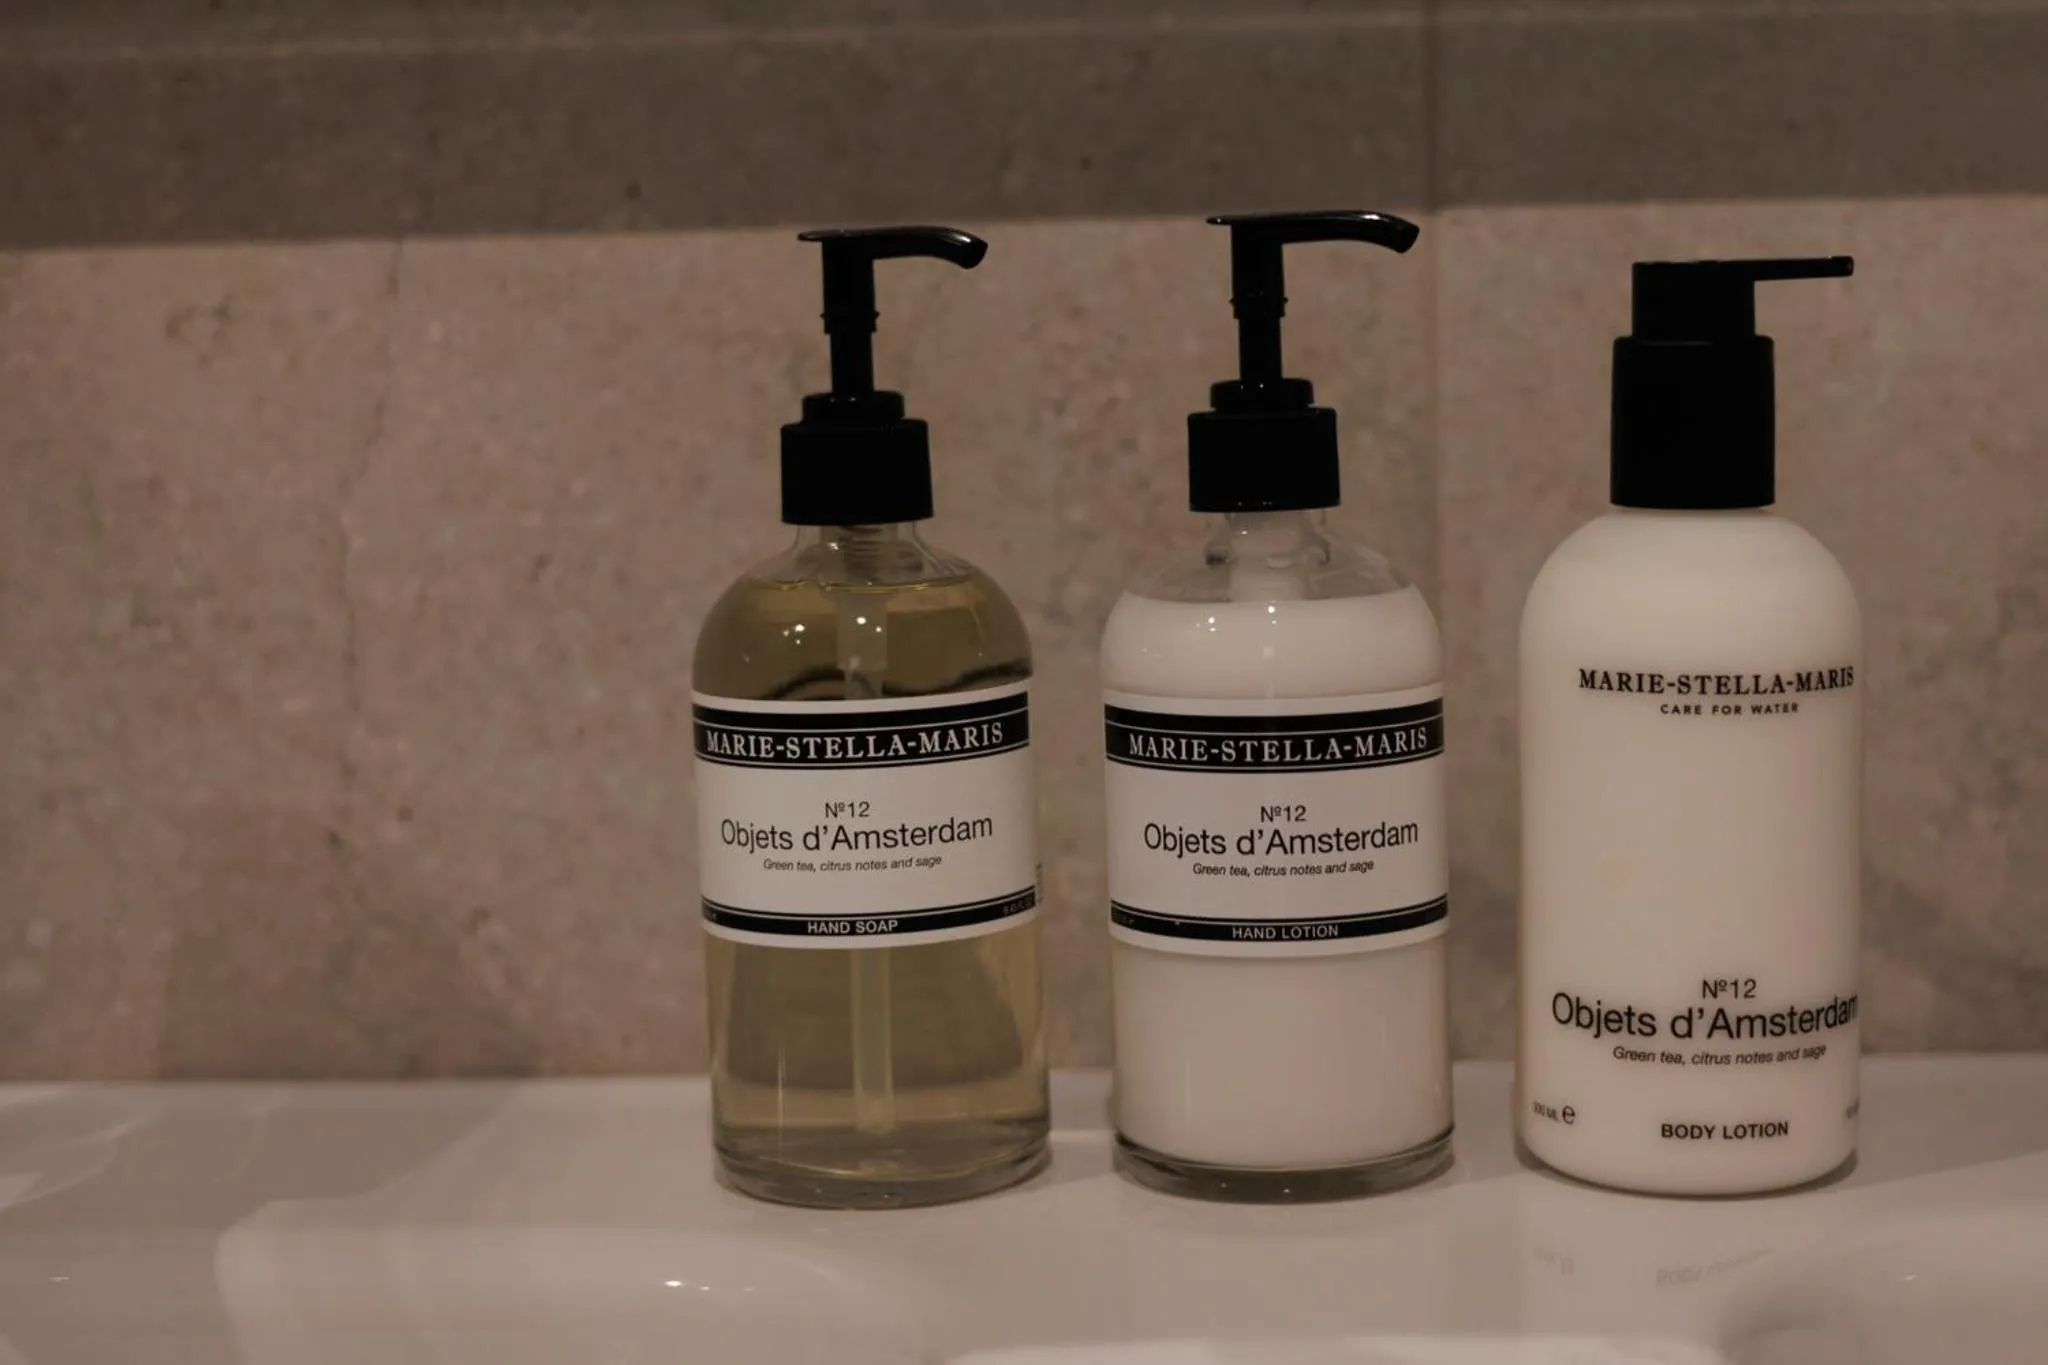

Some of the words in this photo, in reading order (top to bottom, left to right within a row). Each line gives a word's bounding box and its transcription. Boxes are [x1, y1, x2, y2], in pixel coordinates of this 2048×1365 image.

[1578, 665, 1855, 696] MARIE-STELLA-MARIS
[1660, 703, 1703, 716] CARE
[1711, 703, 1743, 716] FOR
[1750, 702, 1799, 715] WATER
[706, 721, 1003, 760] MARIE-STELLA-MARIS
[1129, 726, 1428, 763] MARIE-STELLA-MARIS
[720, 818, 794, 853] Objets
[802, 816, 993, 851] d’Amsterdam
[1144, 823, 1227, 859] Objets
[1236, 821, 1419, 856] d’Amsterdam
[763, 858, 794, 871] Green
[797, 861, 817, 873] tea,
[820, 860, 852, 872] citrus
[855, 859, 888, 871] notes
[891, 856, 913, 869] and
[916, 854, 942, 868] sage
[1192, 862, 1227, 875] Green
[1229, 865, 1251, 877] tea,
[1254, 865, 1287, 876] citrus
[1290, 864, 1322, 876] notes
[1325, 861, 1347, 873] and
[1349, 860, 1375, 874] sage
[807, 920, 850, 934] HAND
[855, 919, 899, 934] SOAP
[1232, 926, 1276, 940] HAND
[1281, 924, 1339, 939] LOTION
[1552, 992, 1657, 1038] Objets
[1612, 1045, 1656, 1062] Green
[1660, 1050, 1686, 1065] tea,
[1691, 1051, 1731, 1065] citrus
[1735, 1051, 1773, 1065] notes
[1776, 1047, 1800, 1062] and
[1802, 1045, 1827, 1060] sage
[1661, 1123, 1716, 1140] BODY
[1722, 1121, 1789, 1140] LOTION
